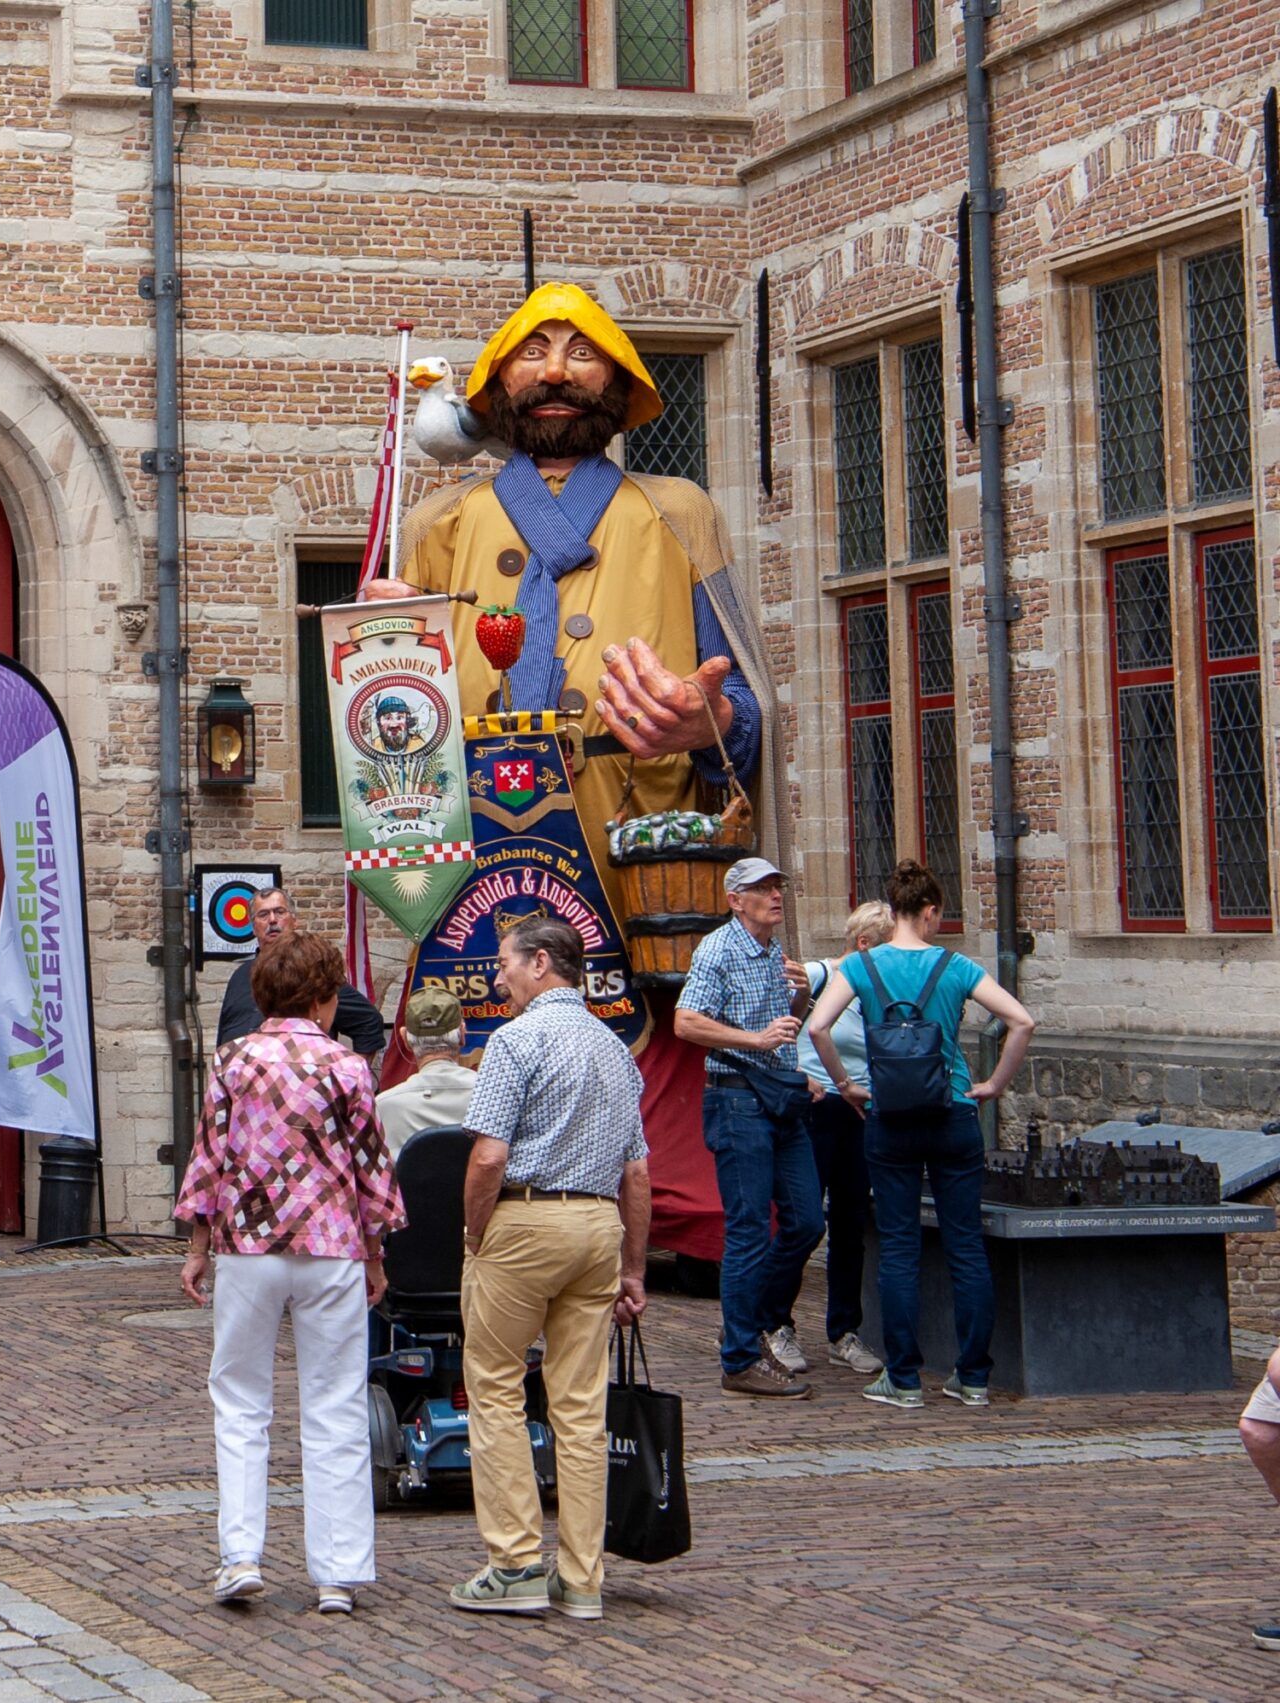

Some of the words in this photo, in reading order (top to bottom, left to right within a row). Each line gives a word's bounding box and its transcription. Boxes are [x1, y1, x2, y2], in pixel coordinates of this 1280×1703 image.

[360, 621, 415, 634] ANSJOVION
[348, 657, 437, 685] AMBASSADEUR
[373, 796, 433, 811] BRABANTSE
[387, 823, 426, 834] WAL
[475, 847, 552, 870] Brabantse
[556, 856, 582, 882] Wal
[436, 871, 518, 952] Aspergilda
[521, 867, 535, 894] &
[538, 871, 604, 951] Ansjovion
[454, 962, 500, 971] muzie
[580, 969, 625, 999] ES
[462, 1001, 512, 1019] rebe
[585, 997, 635, 1018] kest
[608, 1431, 637, 1455] Lux
[661, 1471, 670, 1496] Sleep
